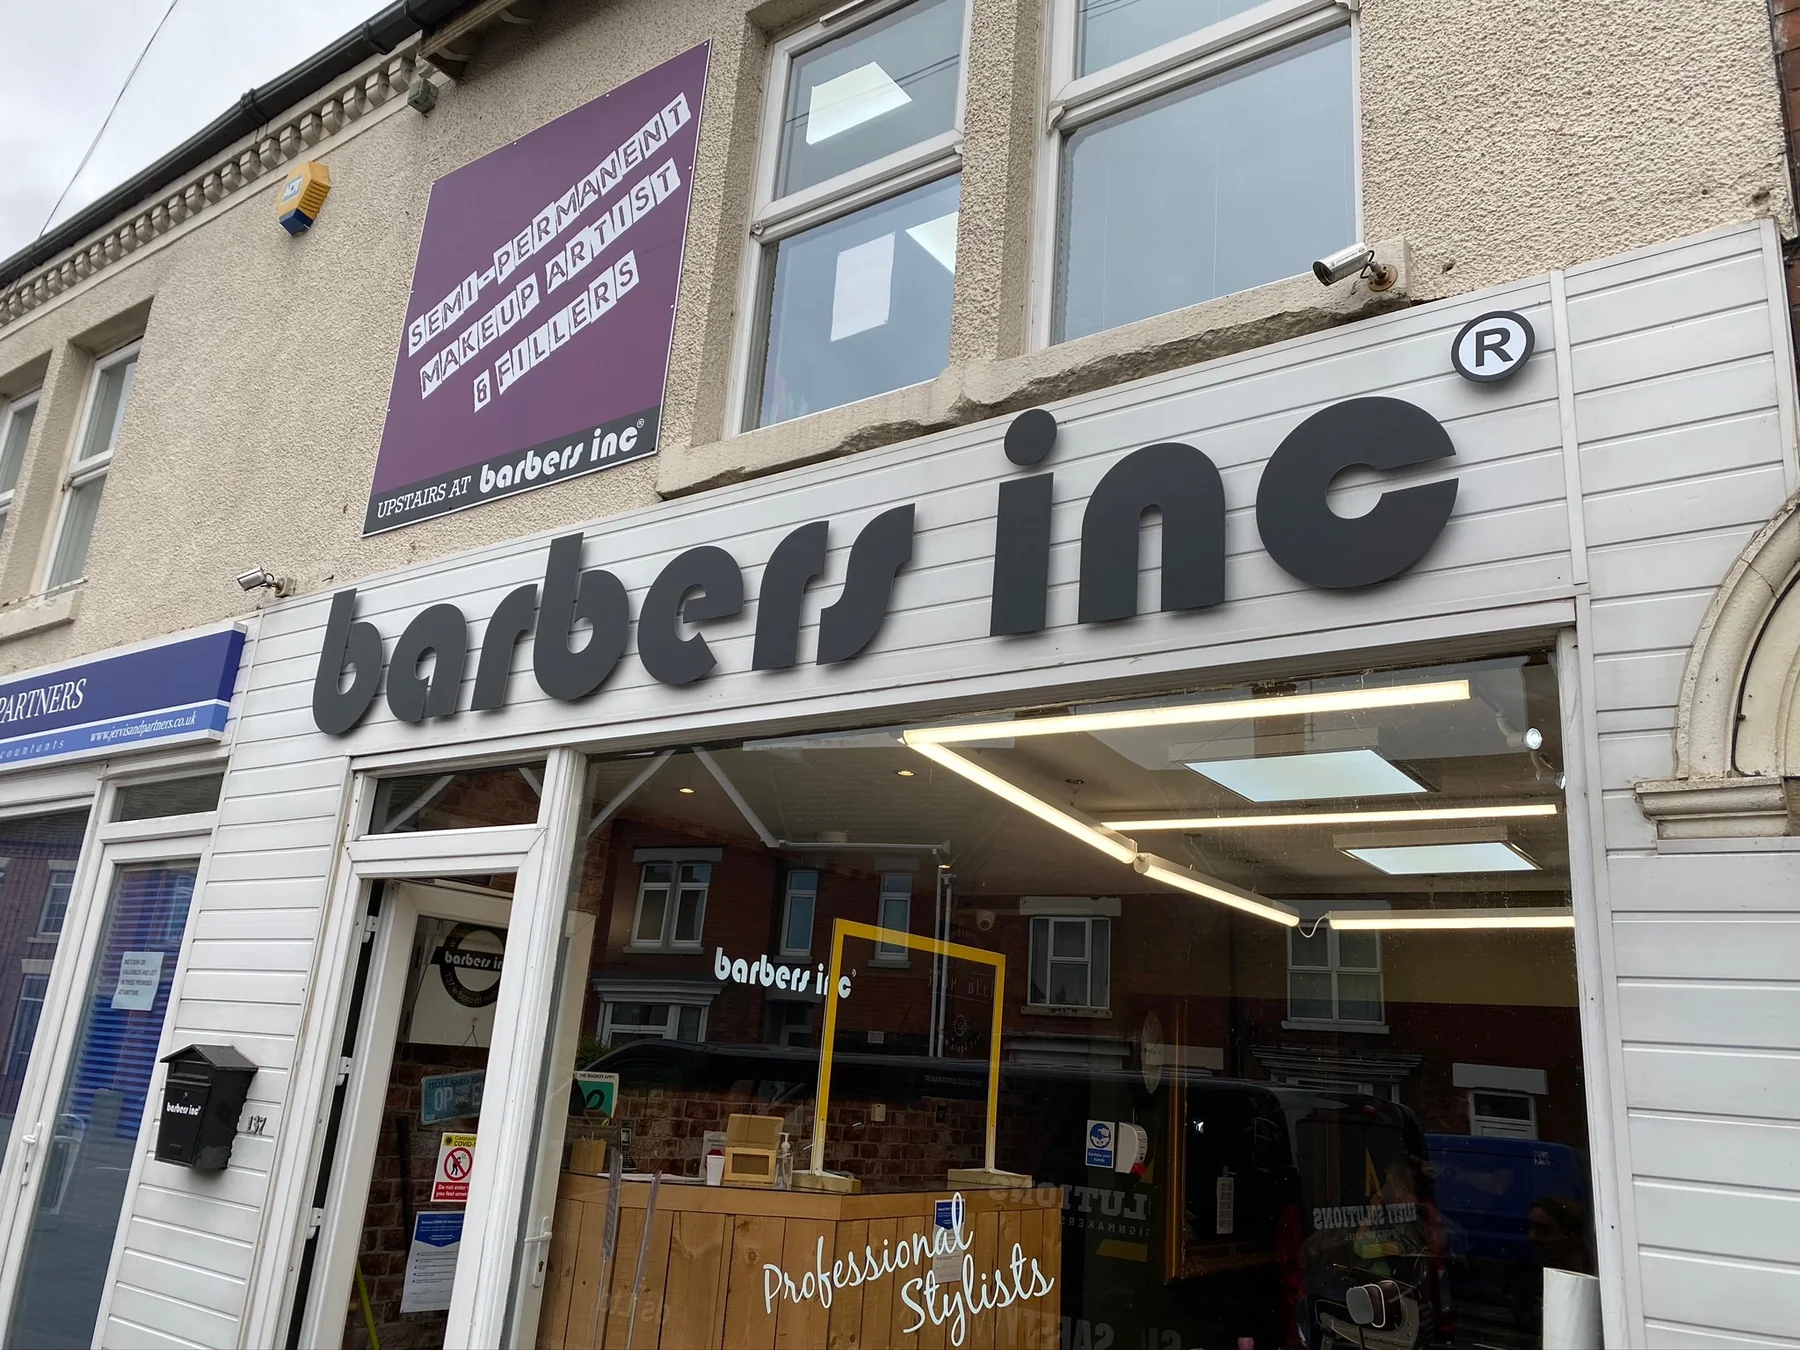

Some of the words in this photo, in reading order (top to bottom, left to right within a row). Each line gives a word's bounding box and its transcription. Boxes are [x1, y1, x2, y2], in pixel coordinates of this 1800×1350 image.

[283, 176, 303, 197] ADT
[409, 95, 688, 351] SEMI-PERMANENT
[421, 279, 536, 396] MAKEUP
[548, 163, 676, 290] ARTIST
[498, 256, 637, 390] FILLERS
[377, 482, 446, 519] UPSTAIRS
[448, 475, 471, 499] AT
[479, 441, 584, 494] barbers
[312, 503, 915, 736] barbers
[990, 395, 1459, 636] inc
[0, 677, 88, 724] PARTNERS
[90, 710, 197, 742] www.jervisandpartners.co.uk
[444, 950, 491, 968] barbers
[714, 946, 811, 993] barbers
[166, 1101, 189, 1114] barbers
[247, 1115, 268, 1135] 137
[763, 1191, 974, 1315] Professional
[901, 1242, 1055, 1347] Stylists
